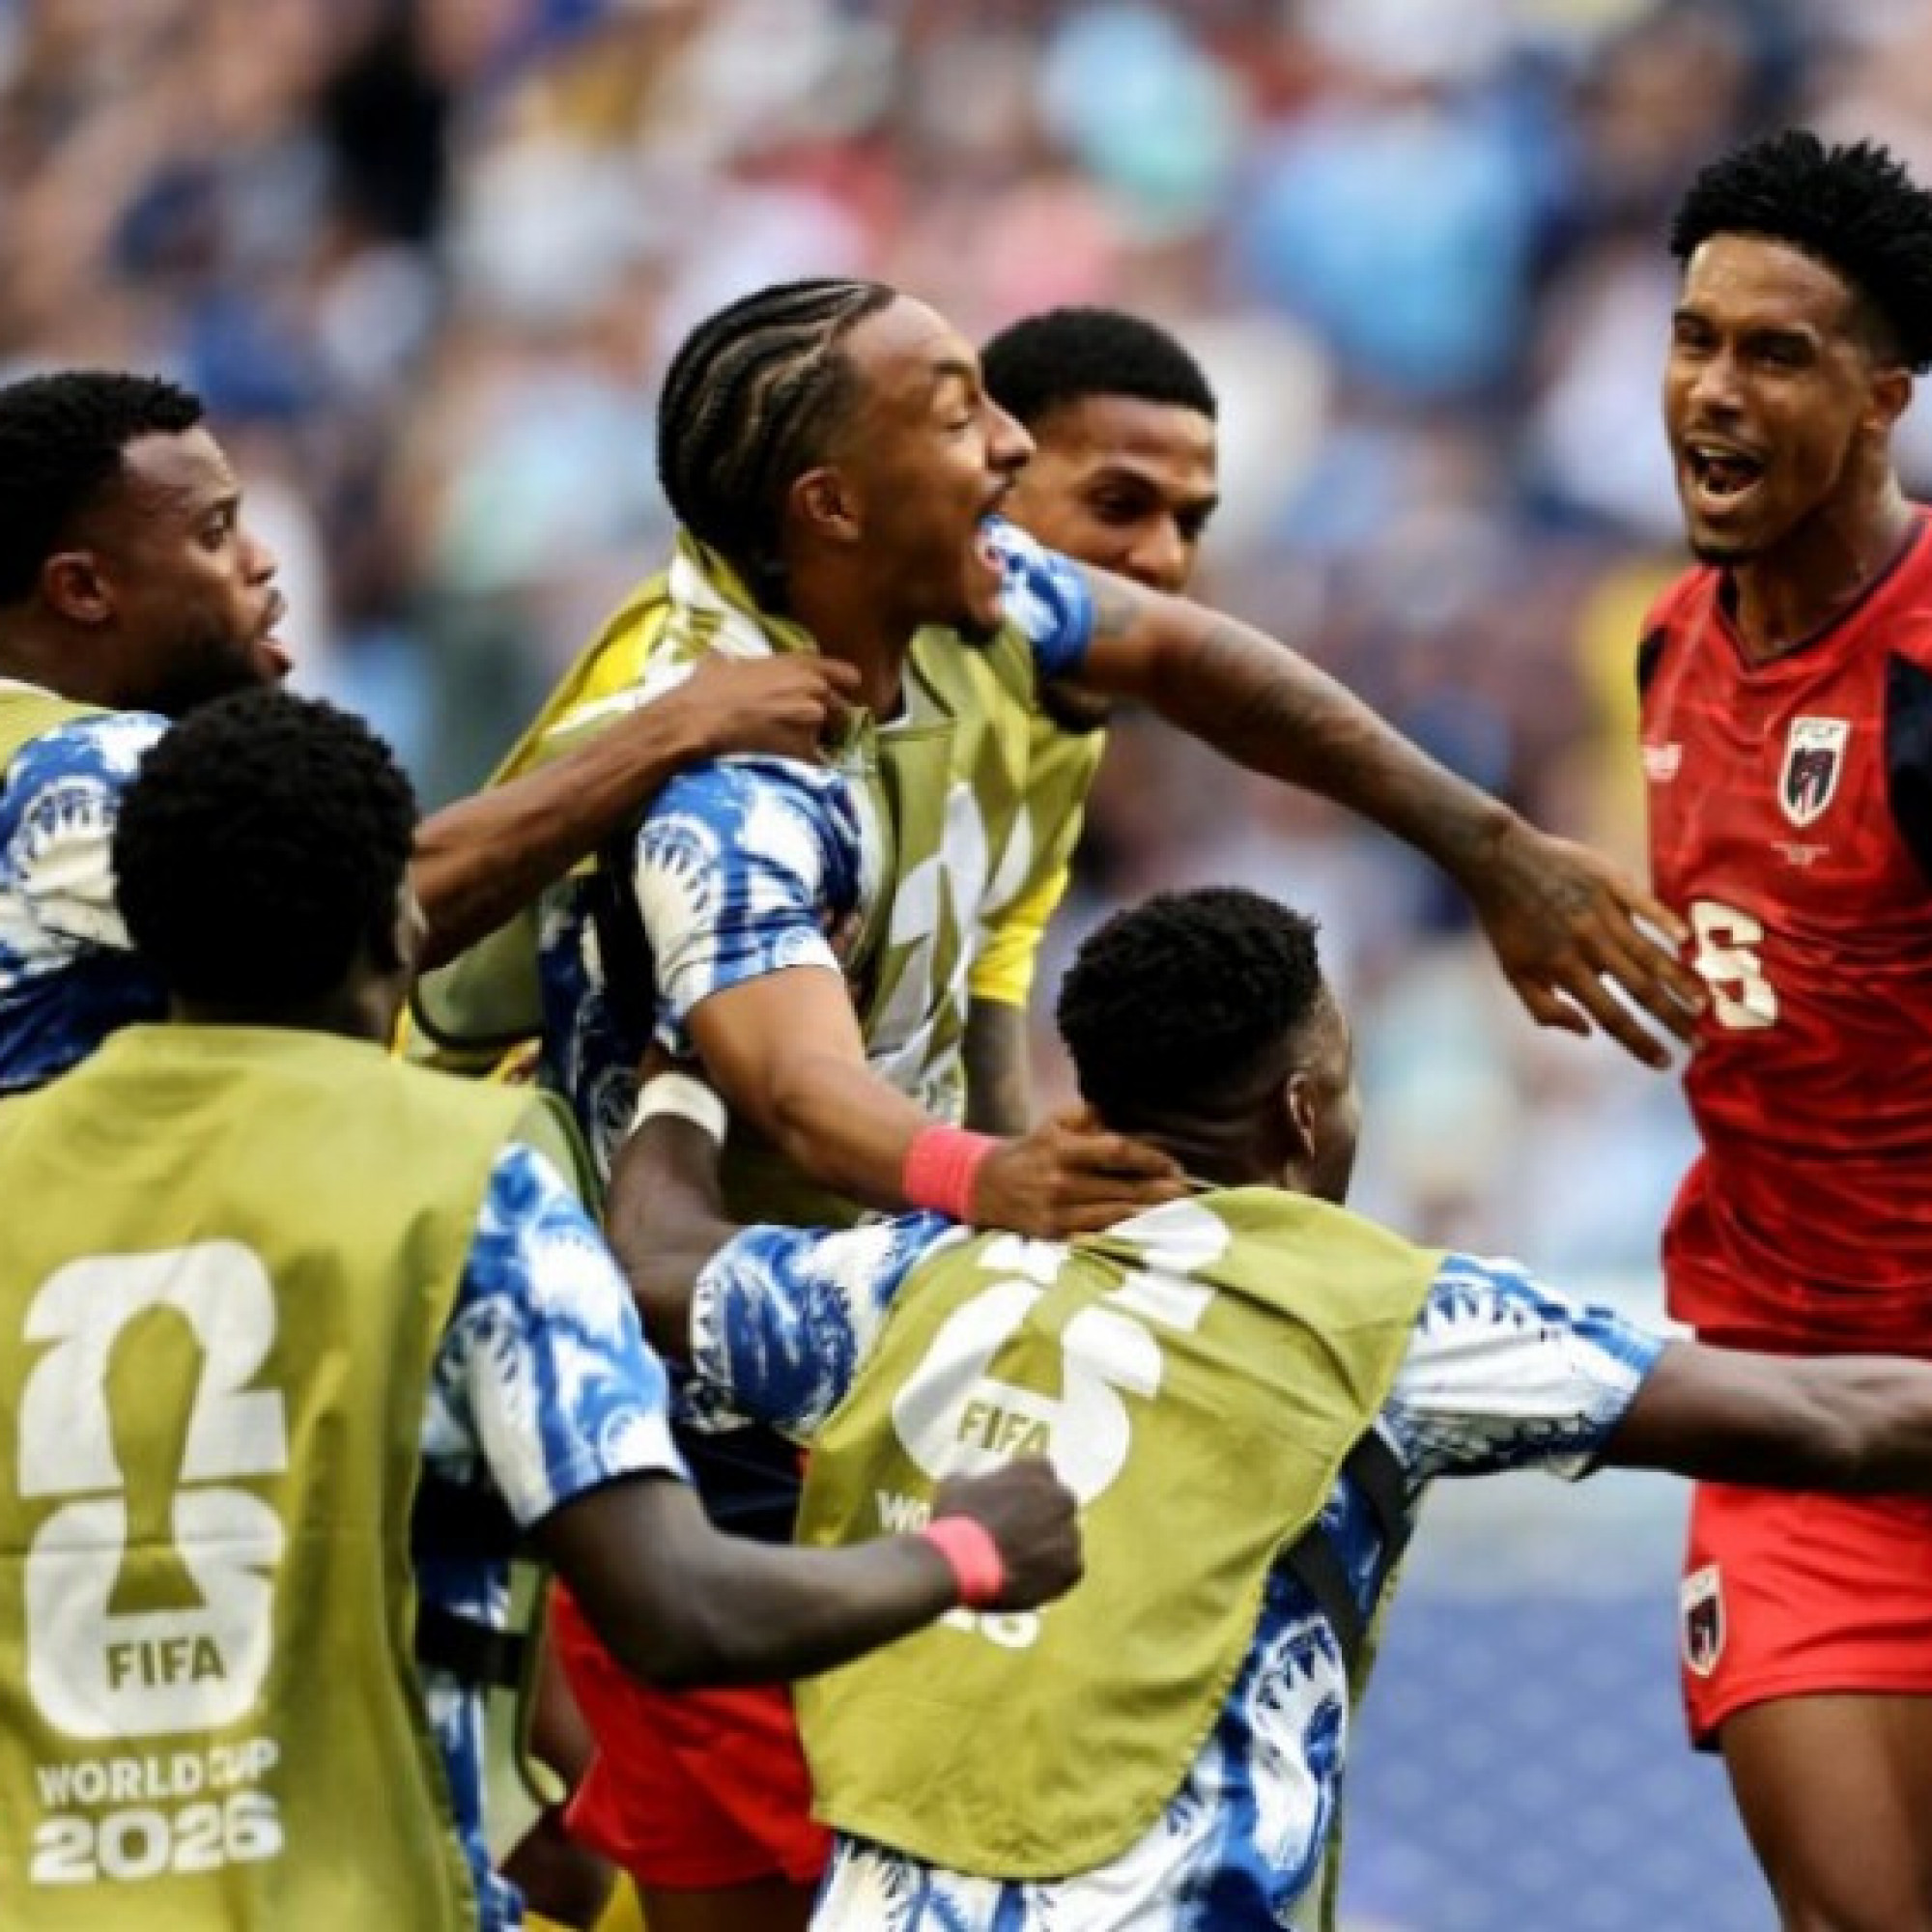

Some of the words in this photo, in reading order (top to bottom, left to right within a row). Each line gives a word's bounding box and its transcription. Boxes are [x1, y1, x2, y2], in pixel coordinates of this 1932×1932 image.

[1690, 900, 1779, 1030] 6
[956, 1399, 1051, 1457] FIFA
[105, 1634, 227, 1691] FIFA
[37, 1751, 203, 1807] WORLD
[30, 1792, 283, 1883] 2026
